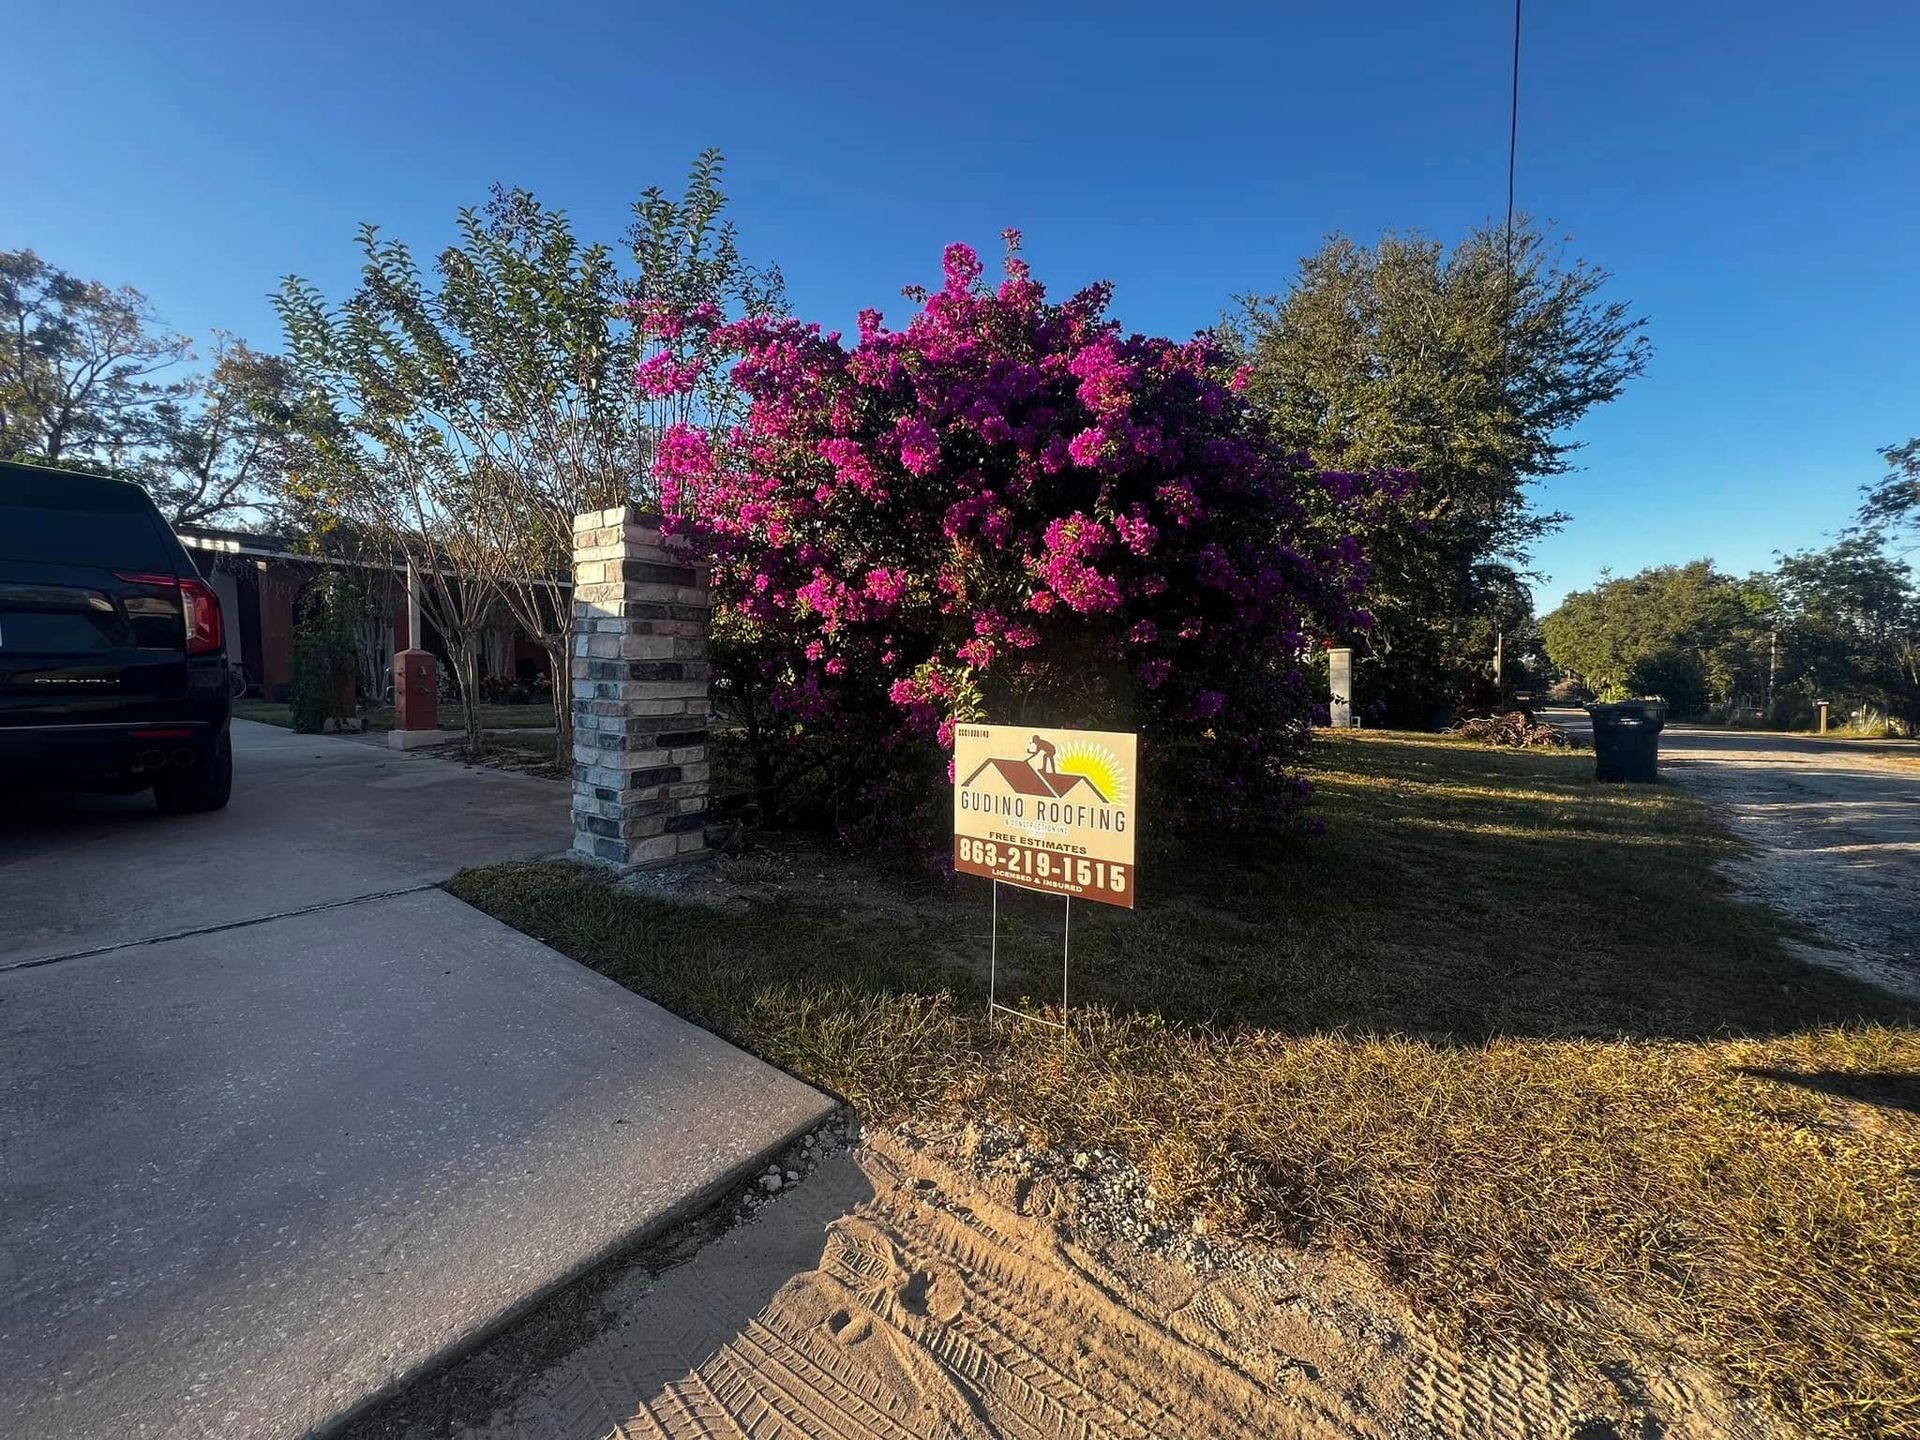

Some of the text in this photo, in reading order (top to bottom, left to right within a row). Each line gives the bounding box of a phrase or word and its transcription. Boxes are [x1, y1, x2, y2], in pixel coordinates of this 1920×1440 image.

[961, 790, 1126, 833] GUDINO ROOFING
[989, 831, 1017, 843] FREE
[1019, 836, 1087, 855] ESTIMATES
[959, 837, 1126, 893] 863-219-1515
[991, 868, 1033, 883] LICENSED
[1042, 879, 1083, 893] INSURED
